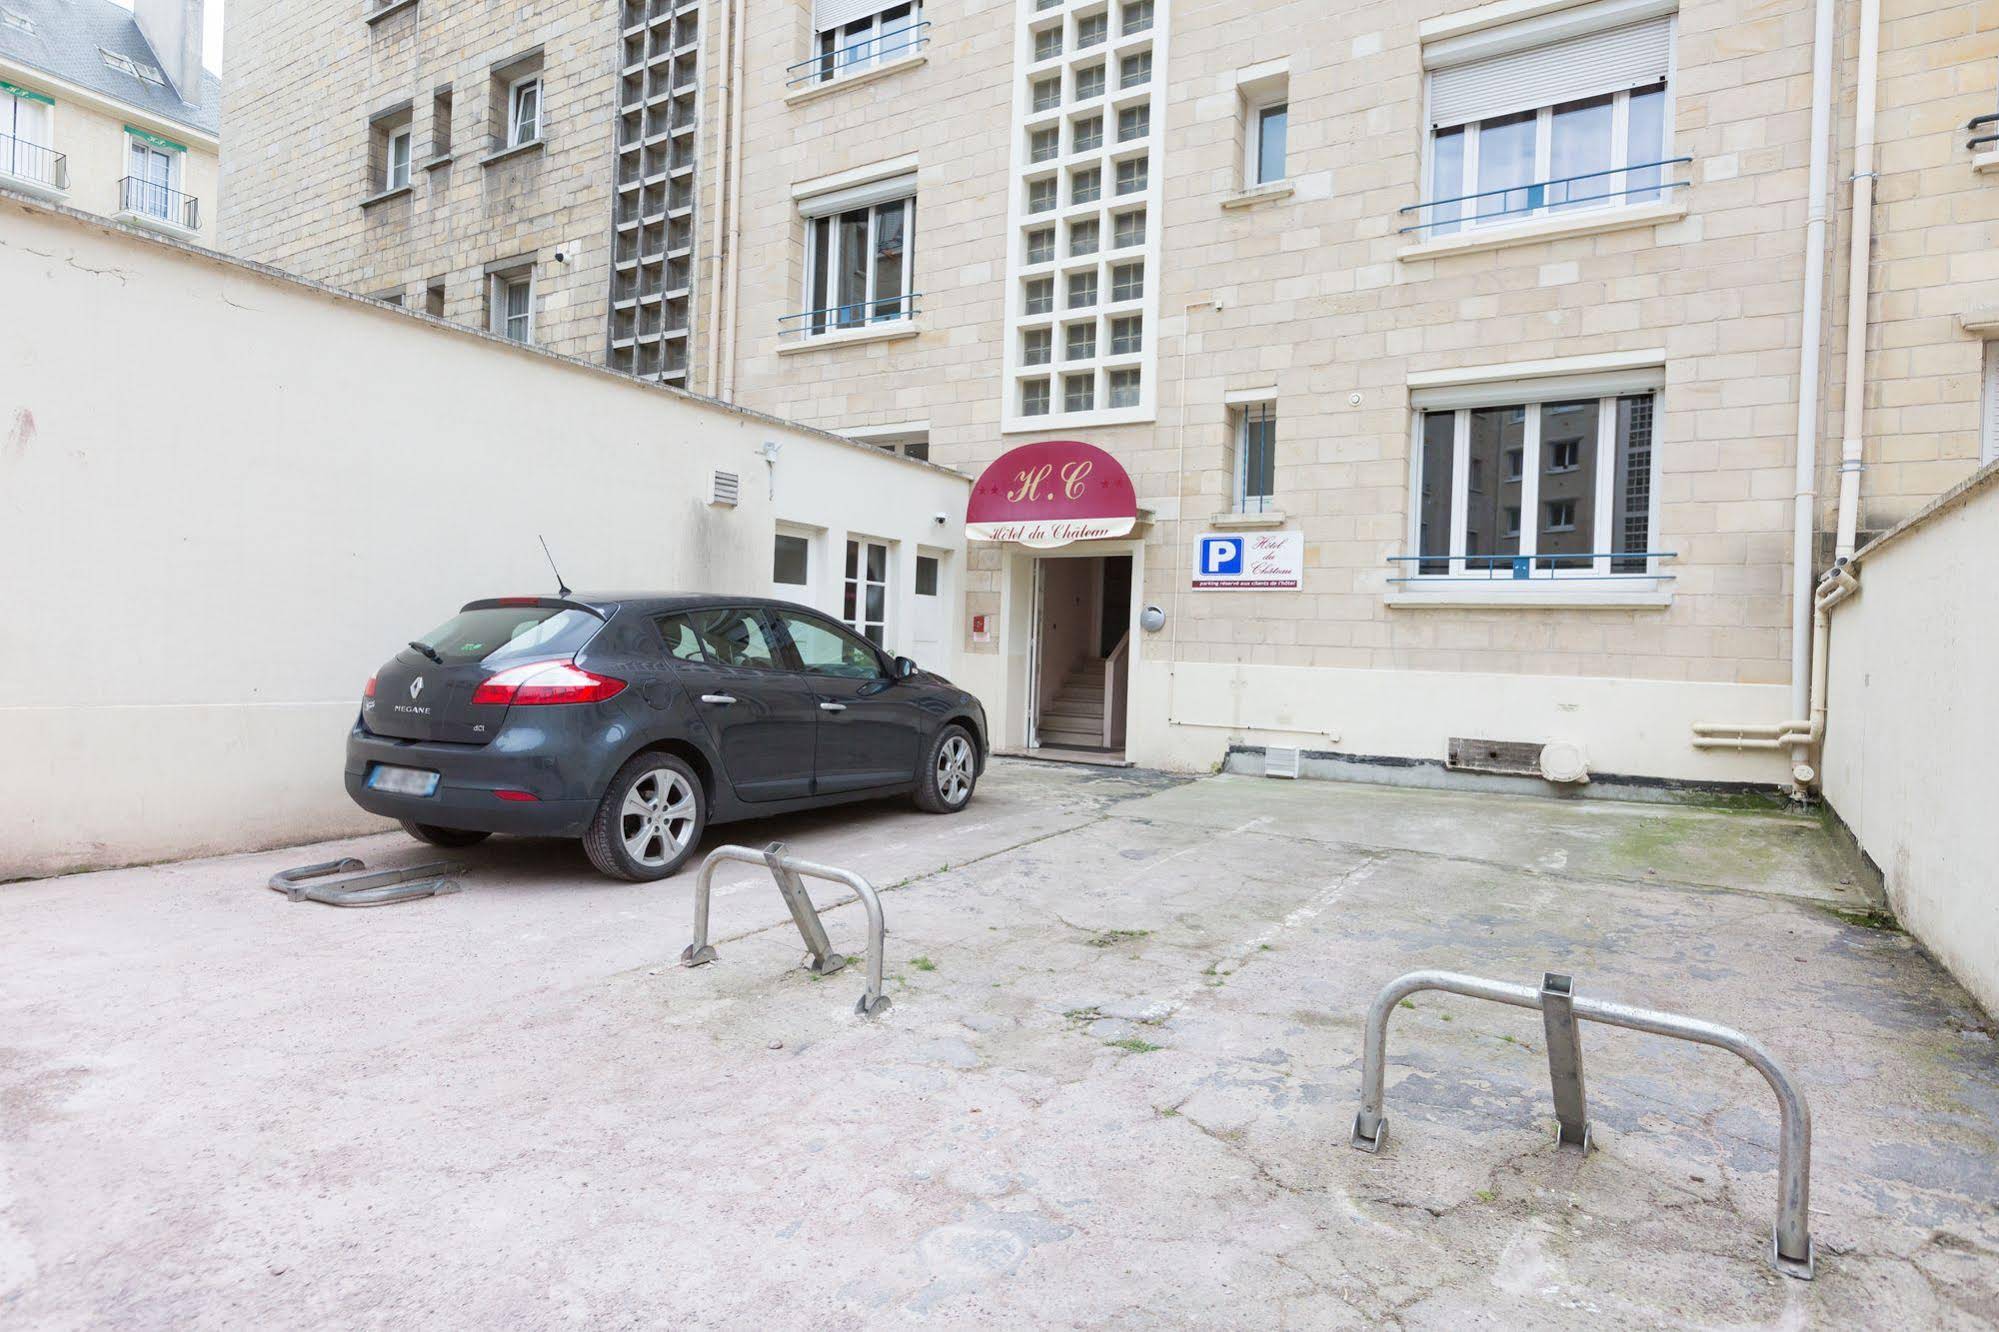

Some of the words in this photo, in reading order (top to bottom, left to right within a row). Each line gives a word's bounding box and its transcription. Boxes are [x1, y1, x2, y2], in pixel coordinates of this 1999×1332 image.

[989, 527, 1025, 540] Hôtel
[1028, 525, 1045, 539] du
[1051, 524, 1109, 539] Château
[1252, 535, 1287, 550] Hôtel
[1208, 541, 1236, 572] P
[1262, 551, 1276, 560] du
[394, 705, 431, 714] MEGANE
